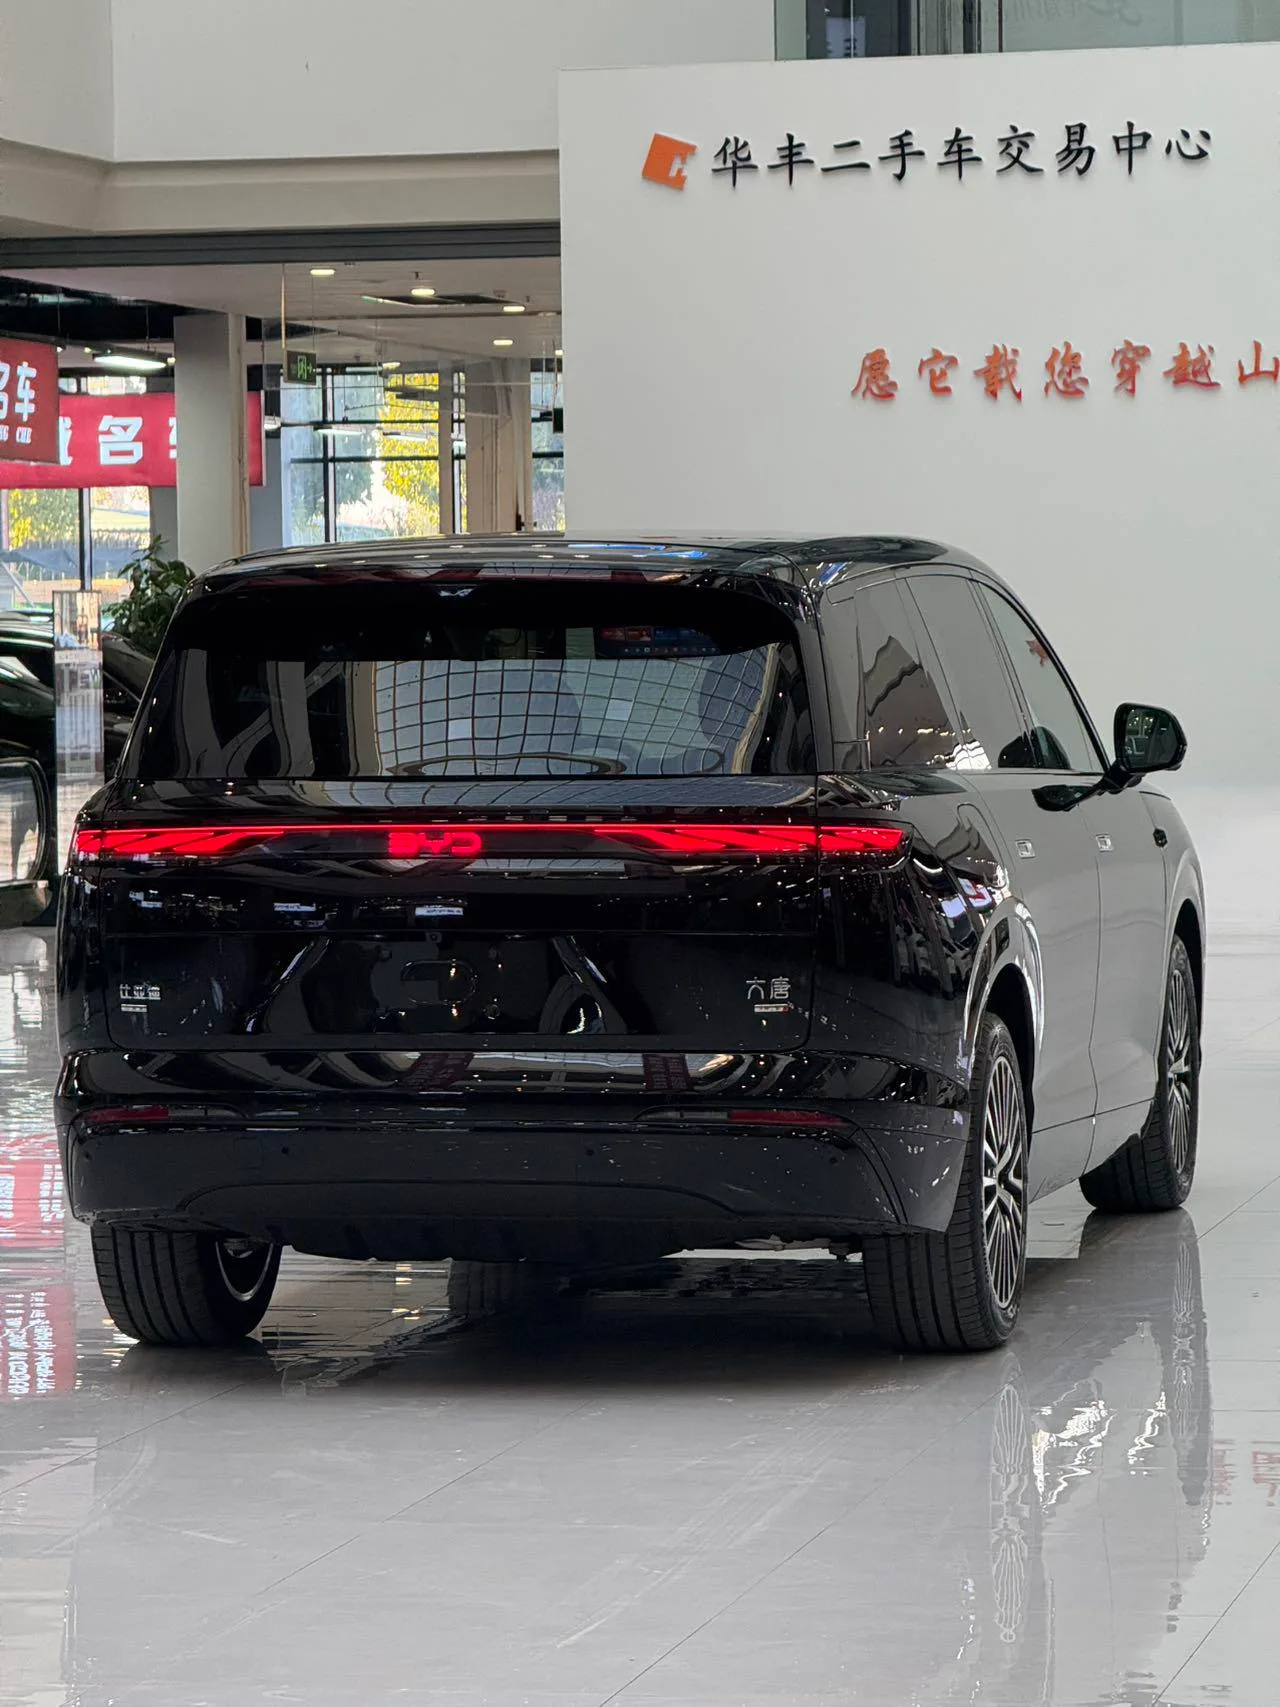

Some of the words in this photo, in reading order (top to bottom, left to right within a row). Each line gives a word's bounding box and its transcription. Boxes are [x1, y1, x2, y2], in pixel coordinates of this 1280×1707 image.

[711, 121, 1212, 189] 华丰二手车交易中心
[388, 831, 482, 855] BYD
